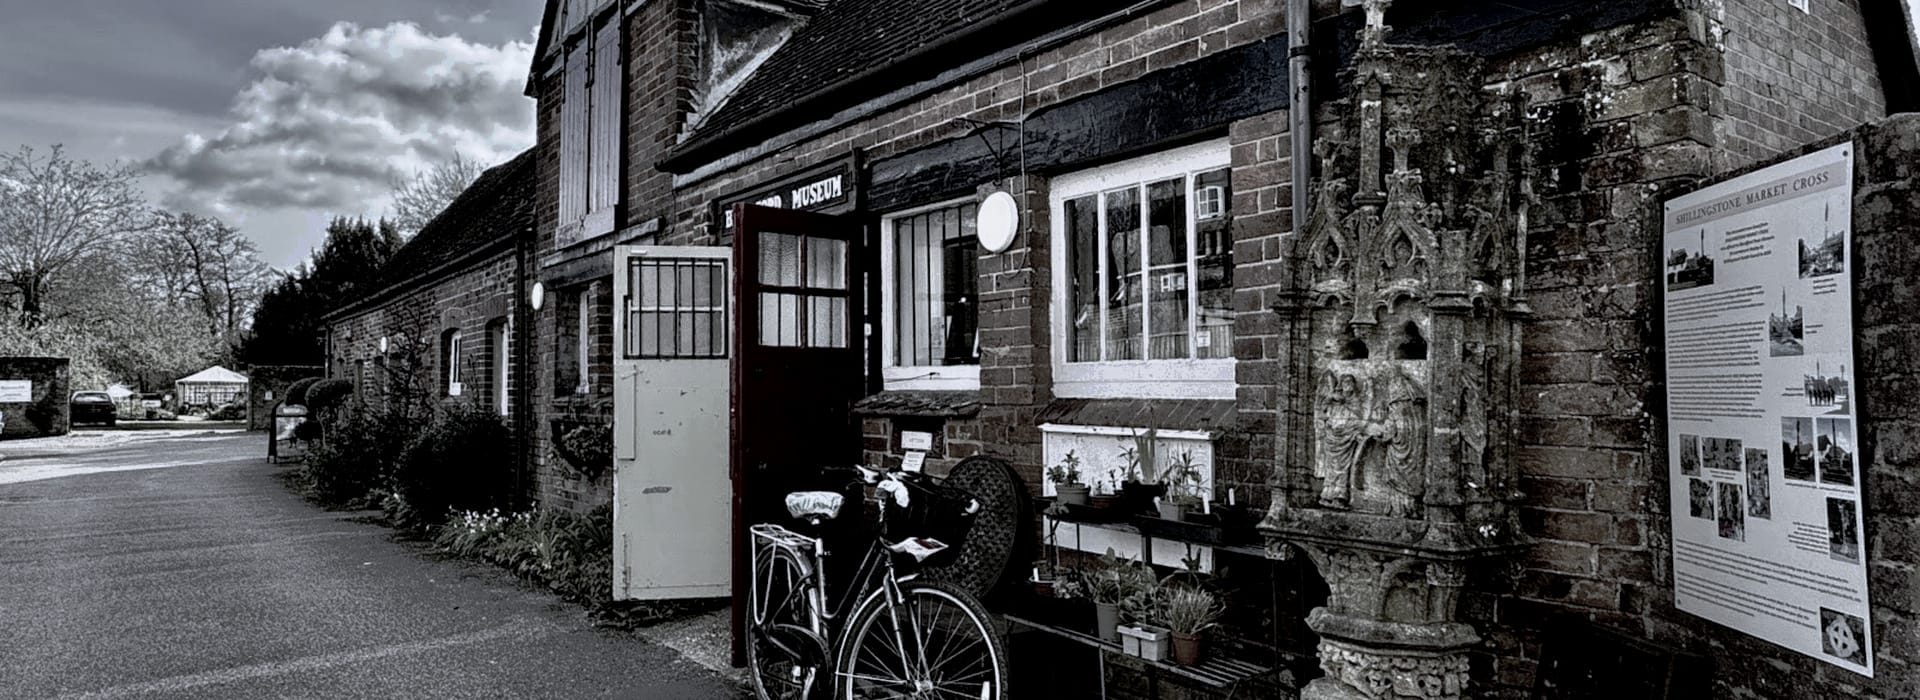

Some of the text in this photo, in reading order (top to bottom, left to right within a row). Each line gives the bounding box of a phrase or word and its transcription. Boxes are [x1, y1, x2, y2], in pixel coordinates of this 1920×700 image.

[792, 174, 842, 210] MUSEUM
[1675, 171, 1829, 225] SHILLINGSTONE MARKET CROSS
